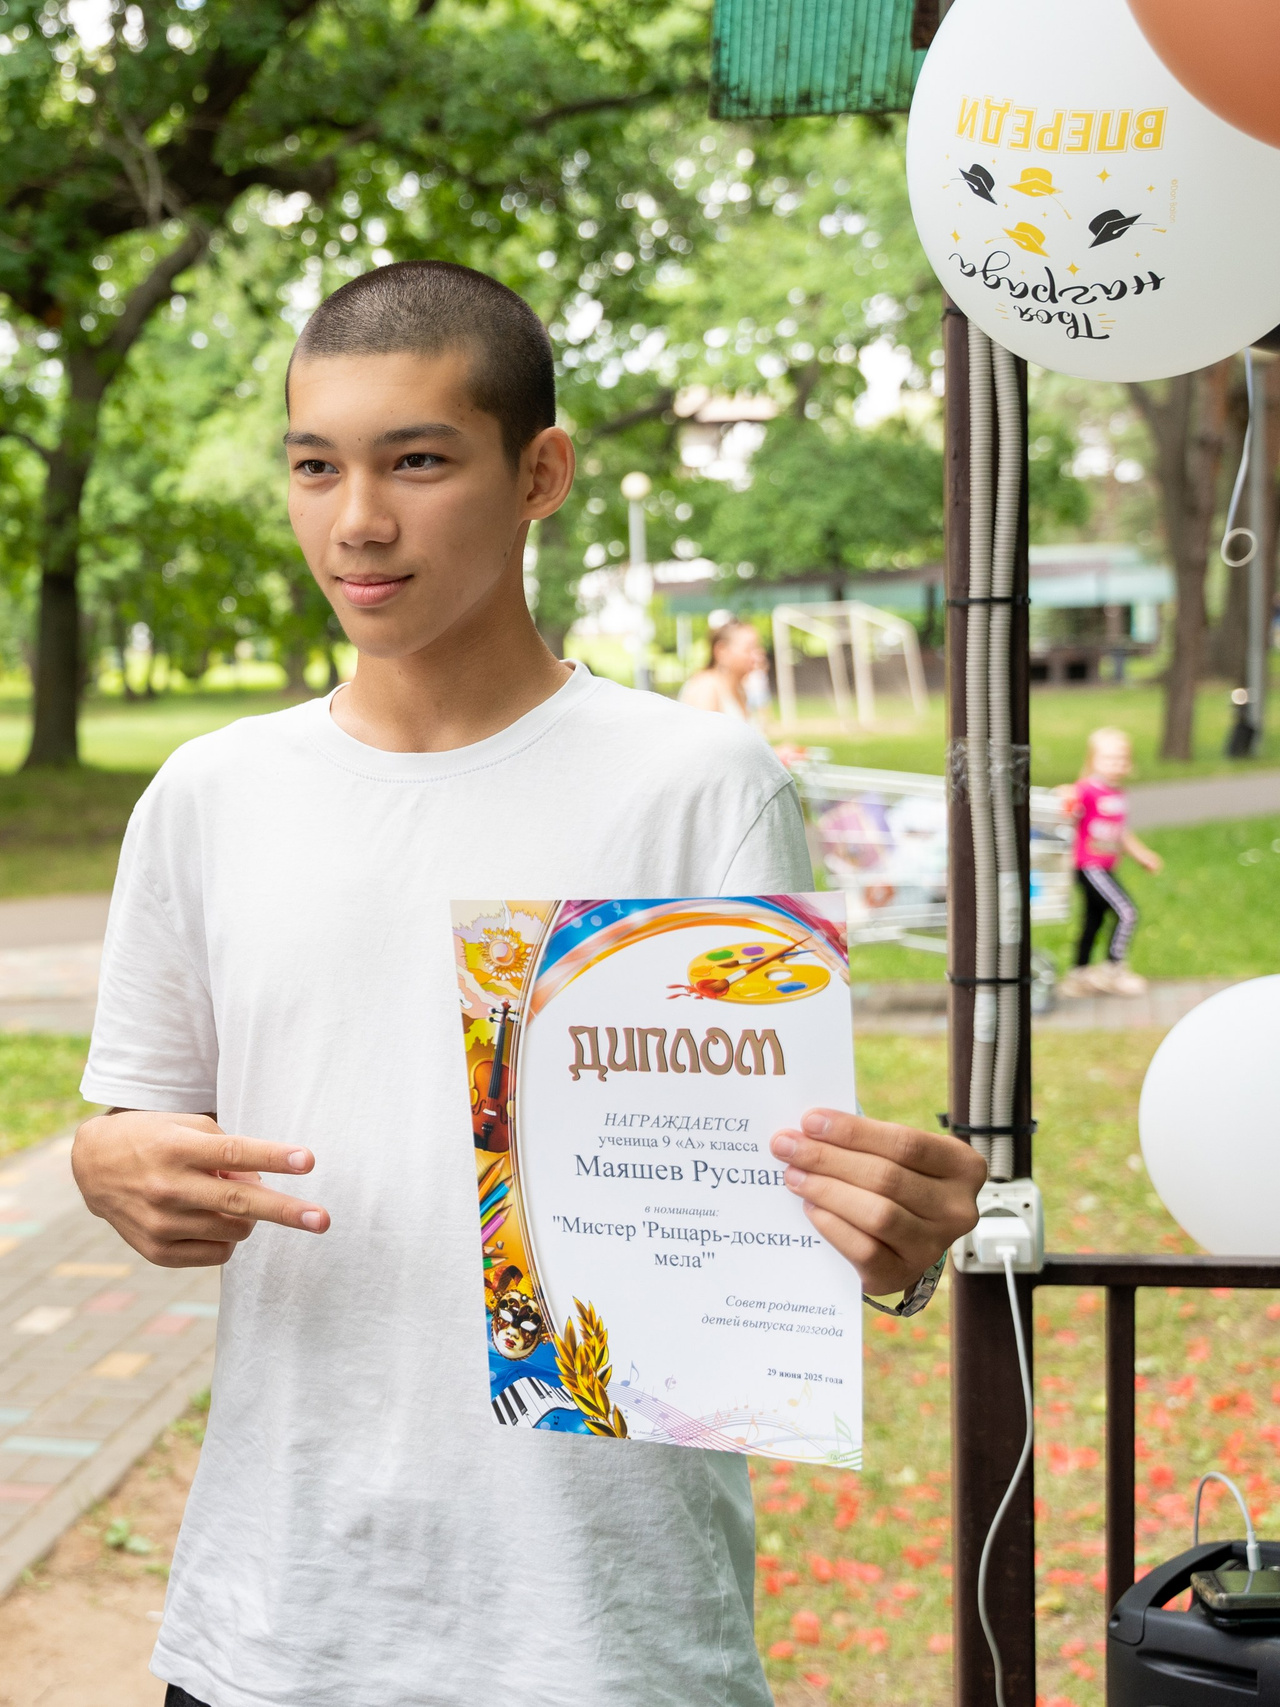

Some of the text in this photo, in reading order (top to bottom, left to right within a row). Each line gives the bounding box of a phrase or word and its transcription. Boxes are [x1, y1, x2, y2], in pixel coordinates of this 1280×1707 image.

[955, 94, 1169, 155] ВПЕРЕДИ
[948, 251, 1165, 304] награда
[1013, 305, 1110, 340] Твоя
[568, 1025, 786, 1082] ДИПЛОМ
[603, 1112, 750, 1132] НАГРАЖДАЕТСЯ
[598, 1135, 659, 1148] ученица
[662, 1135, 670, 1148] 9
[710, 1141, 759, 1152] класса
[574, 1154, 786, 1189] Маяшев Руслан
[644, 1205, 720, 1219] в номинации:
[552, 1215, 637, 1241] "Мистер
[725, 1294, 766, 1309] Совет
[767, 1300, 837, 1316] родителей
[701, 1313, 741, 1327] детей
[742, 1319, 794, 1332] выпуска
[767, 1368, 843, 1385] 29 июня 2025 года
